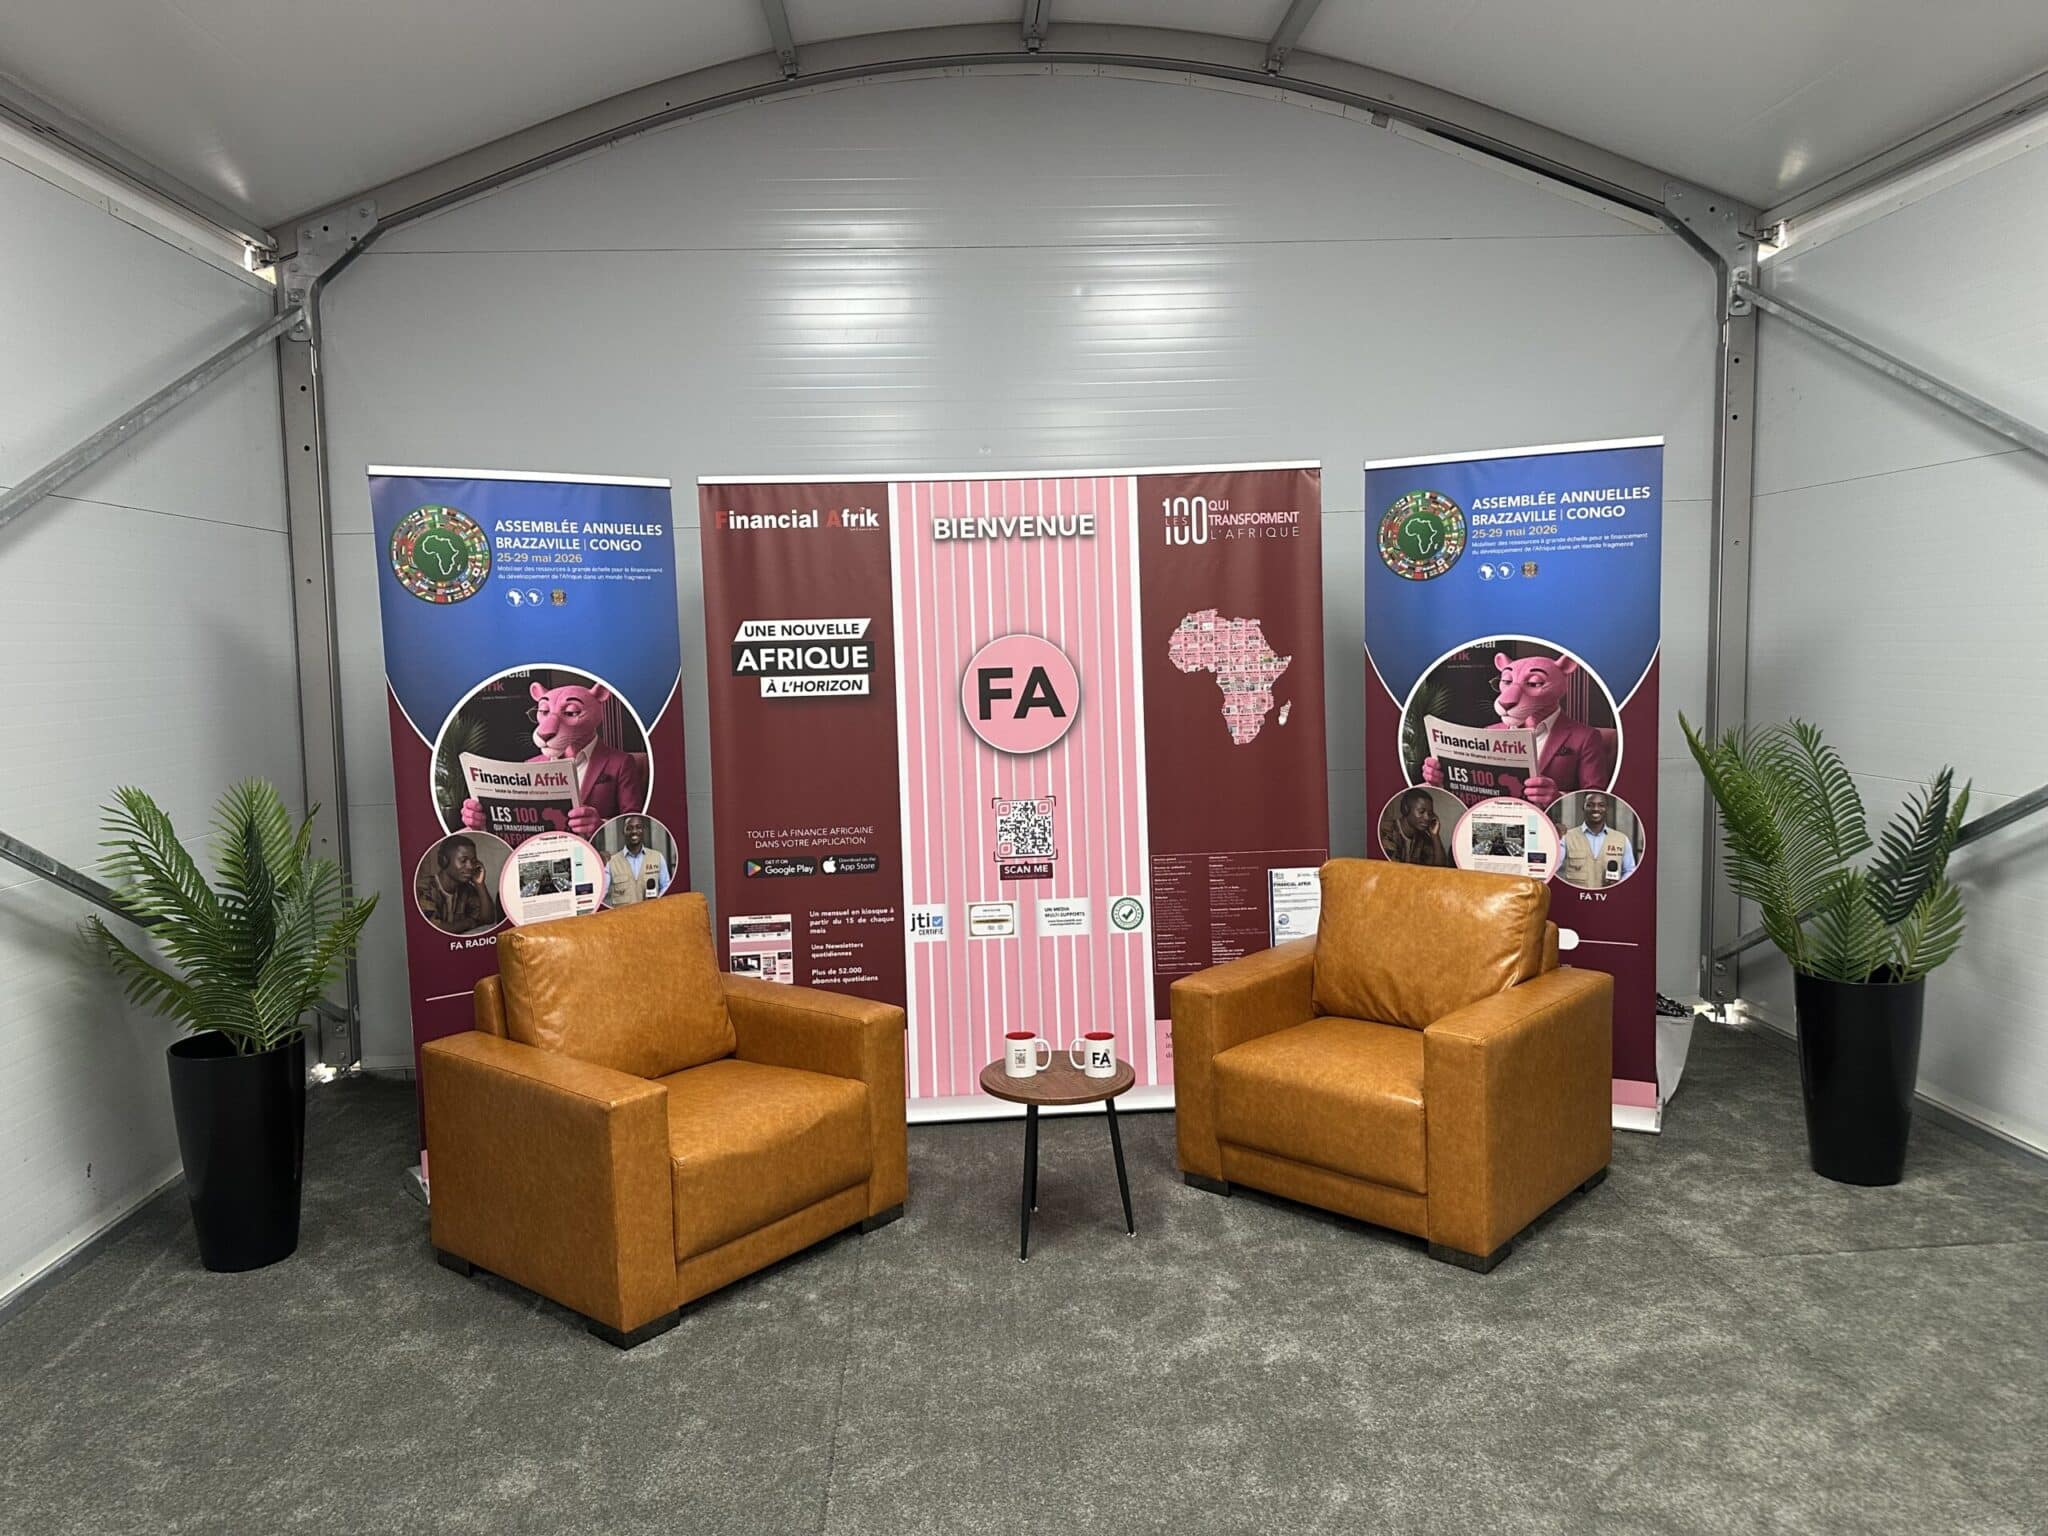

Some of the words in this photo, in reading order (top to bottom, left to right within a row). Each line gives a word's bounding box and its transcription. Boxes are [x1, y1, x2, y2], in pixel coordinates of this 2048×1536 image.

[1472, 490, 1556, 510] ASSEMBLÉE
[1560, 486, 1651, 504] ANNUELLES
[1208, 500, 1229, 511] QUI
[715, 509, 819, 529] Financial
[826, 506, 880, 528] Afrik
[1162, 496, 1207, 546] 100
[1165, 517, 1188, 526] LES
[1208, 511, 1300, 526] TRANSFORMENT
[1472, 509, 1556, 526] BRAZZAVILLE
[1566, 505, 1626, 520] CONGO
[495, 519, 578, 533] ASSEMBLÉE
[583, 523, 662, 536] ANNUELLES
[933, 514, 1095, 539] BIENVENUE
[1210, 526, 1300, 540] L'AFRIQUE
[1471, 528, 1503, 539] 25-29
[1505, 527, 1526, 537] mai
[1528, 525, 1558, 536] 2026
[496, 537, 580, 550] BRAZZAVILLE
[589, 539, 641, 551] CONGO
[497, 553, 528, 563] 25-29
[532, 554, 551, 563] mai
[554, 553, 583, 563] 2026
[744, 625, 777, 637] UNE
[781, 623, 860, 637] NOUVELLE
[736, 645, 869, 672] AFRIQUE
[766, 679, 777, 693] À
[782, 679, 863, 693] L'HORIZON
[977, 666, 1067, 720] FA
[1432, 729, 1490, 751] Financial
[1492, 740, 1527, 754] Afrik
[469, 767, 531, 786] Financial
[534, 772, 569, 786] Afrik
[1448, 765, 1468, 783] LES
[1471, 769, 1494, 787] 100
[490, 806, 512, 823] LES
[513, 808, 538, 823] 100
[504, 824, 545, 832] TRANSFORMENT
[747, 830, 775, 839] TOUTE
[777, 829, 788, 838] LA
[790, 828, 827, 837] FINANCE
[830, 826, 874, 835] AFRICAINE
[755, 840, 780, 849] DANS
[781, 839, 809, 848] VOTRE
[811, 836, 866, 847] APPLICATION
[765, 865, 795, 875] Google
[796, 864, 814, 875] Play
[840, 863, 855, 872] App
[856, 862, 875, 870] Store
[1004, 865, 1031, 874] SCAN
[1034, 864, 1049, 873] ME
[1579, 892, 1592, 901] FA
[1594, 893, 1607, 901] TV
[821, 909, 850, 917] mensuel
[861, 907, 888, 915] kiosque
[809, 919, 829, 927] partir
[910, 912, 930, 932] jti
[450, 941, 463, 951] FA
[465, 936, 497, 949] RADIO
[811, 951, 852, 959] quotidiennes
[811, 968, 826, 976] Plus
[838, 967, 863, 975] 52.000
[842, 975, 879, 984] quotidiens
[1092, 1052, 1110, 1065] FA
